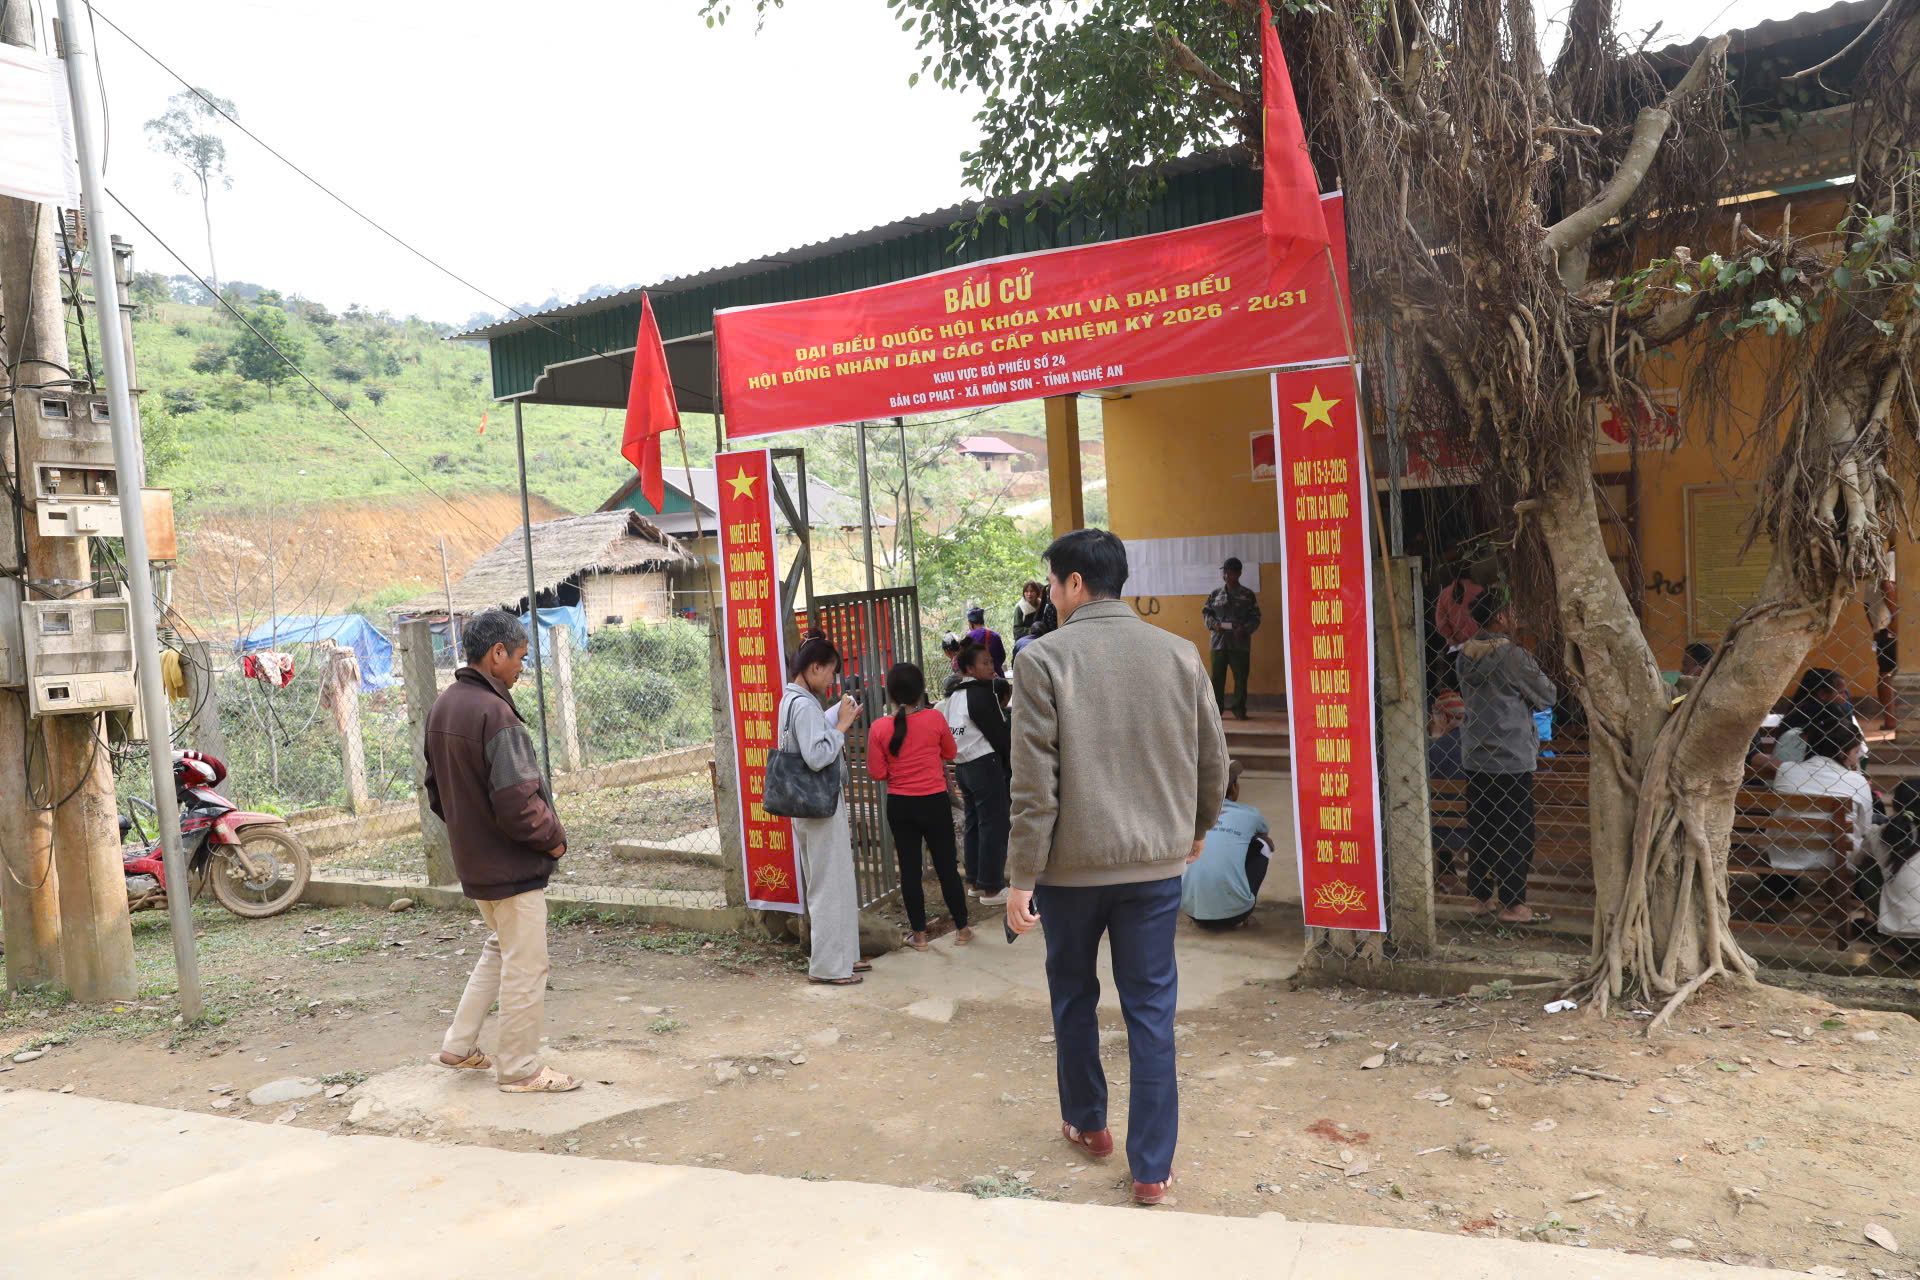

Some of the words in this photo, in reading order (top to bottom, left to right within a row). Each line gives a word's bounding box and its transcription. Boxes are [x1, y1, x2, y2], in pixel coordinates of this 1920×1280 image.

[944, 275, 991, 314] BẦU
[999, 267, 1035, 302] CỬ
[795, 344, 827, 362] ĐẠI
[832, 334, 876, 354] BIỂU
[882, 325, 934, 347] QUỐC
[940, 318, 975, 340] HỘI
[981, 309, 1039, 331] KHÓA
[1046, 303, 1082, 322] XVI
[1088, 293, 1120, 314] VÀ
[1126, 287, 1167, 308] ĐẠI
[1176, 273, 1232, 300] BIỂU
[748, 372, 778, 390] HỘI
[783, 359, 832, 385] ĐỒNG
[836, 353, 889, 377] NHÂN
[895, 345, 936, 367] DÂN
[942, 337, 984, 360] CÁC
[991, 327, 1035, 353] CẤP
[1041, 313, 1118, 346] NHIỆM
[1125, 310, 1156, 333] KỲ
[1162, 304, 1222, 326] 2026
[1247, 289, 1307, 312] 2031
[889, 393, 911, 408] BẢN
[912, 393, 926, 405] CO
[929, 389, 955, 403] PHẠT
[965, 384, 979, 398] XÃ
[982, 381, 1008, 395] MÔN
[1010, 378, 1033, 391] SƠN
[1043, 371, 1070, 386] TỈNH
[1072, 366, 1104, 382] NGHỆ
[1106, 364, 1123, 377] AN
[933, 371, 955, 384] KHU
[957, 367, 978, 381] VỰC
[980, 361, 996, 377] BỎ
[998, 357, 1031, 374] PHIẾU
[1033, 353, 1049, 369] SỐ
[1052, 355, 1066, 367] 24
[1293, 456, 1311, 487] NGÀY
[1312, 459, 1348, 485] 15-3-2026
[1296, 488, 1305, 521] CỬ
[1307, 496, 1317, 520] TRI
[1318, 487, 1329, 520] CẢ
[1329, 490, 1349, 519] NƯỚC
[1306, 532, 1315, 555] ĐI
[1317, 521, 1330, 555] BẦU
[1331, 522, 1341, 554] CỬ
[1311, 566, 1323, 595] ĐẠI
[1324, 556, 1340, 589] BIỂU
[1311, 592, 1330, 629] QUỐC
[1331, 596, 1343, 629] HỘI
[1312, 631, 1331, 659] KHÓA
[1333, 635, 1344, 659] XVI
[1310, 665, 1320, 694] VÀ
[1321, 670, 1332, 699] ĐẠI
[1333, 659, 1350, 694] BIỂU
[1316, 699, 1328, 734] HỘI
[1328, 697, 1348, 729] ĐỒNG
[1316, 733, 1335, 763] NHÂN
[1336, 733, 1350, 763] DÂN
[1320, 767, 1334, 797] CÁC
[1335, 765, 1349, 797] CẤP
[1319, 802, 1341, 836] NHIỆM
[1342, 801, 1352, 831] KỲ
[1317, 840, 1333, 863] 2026
[1340, 841, 1359, 865] 2031!
